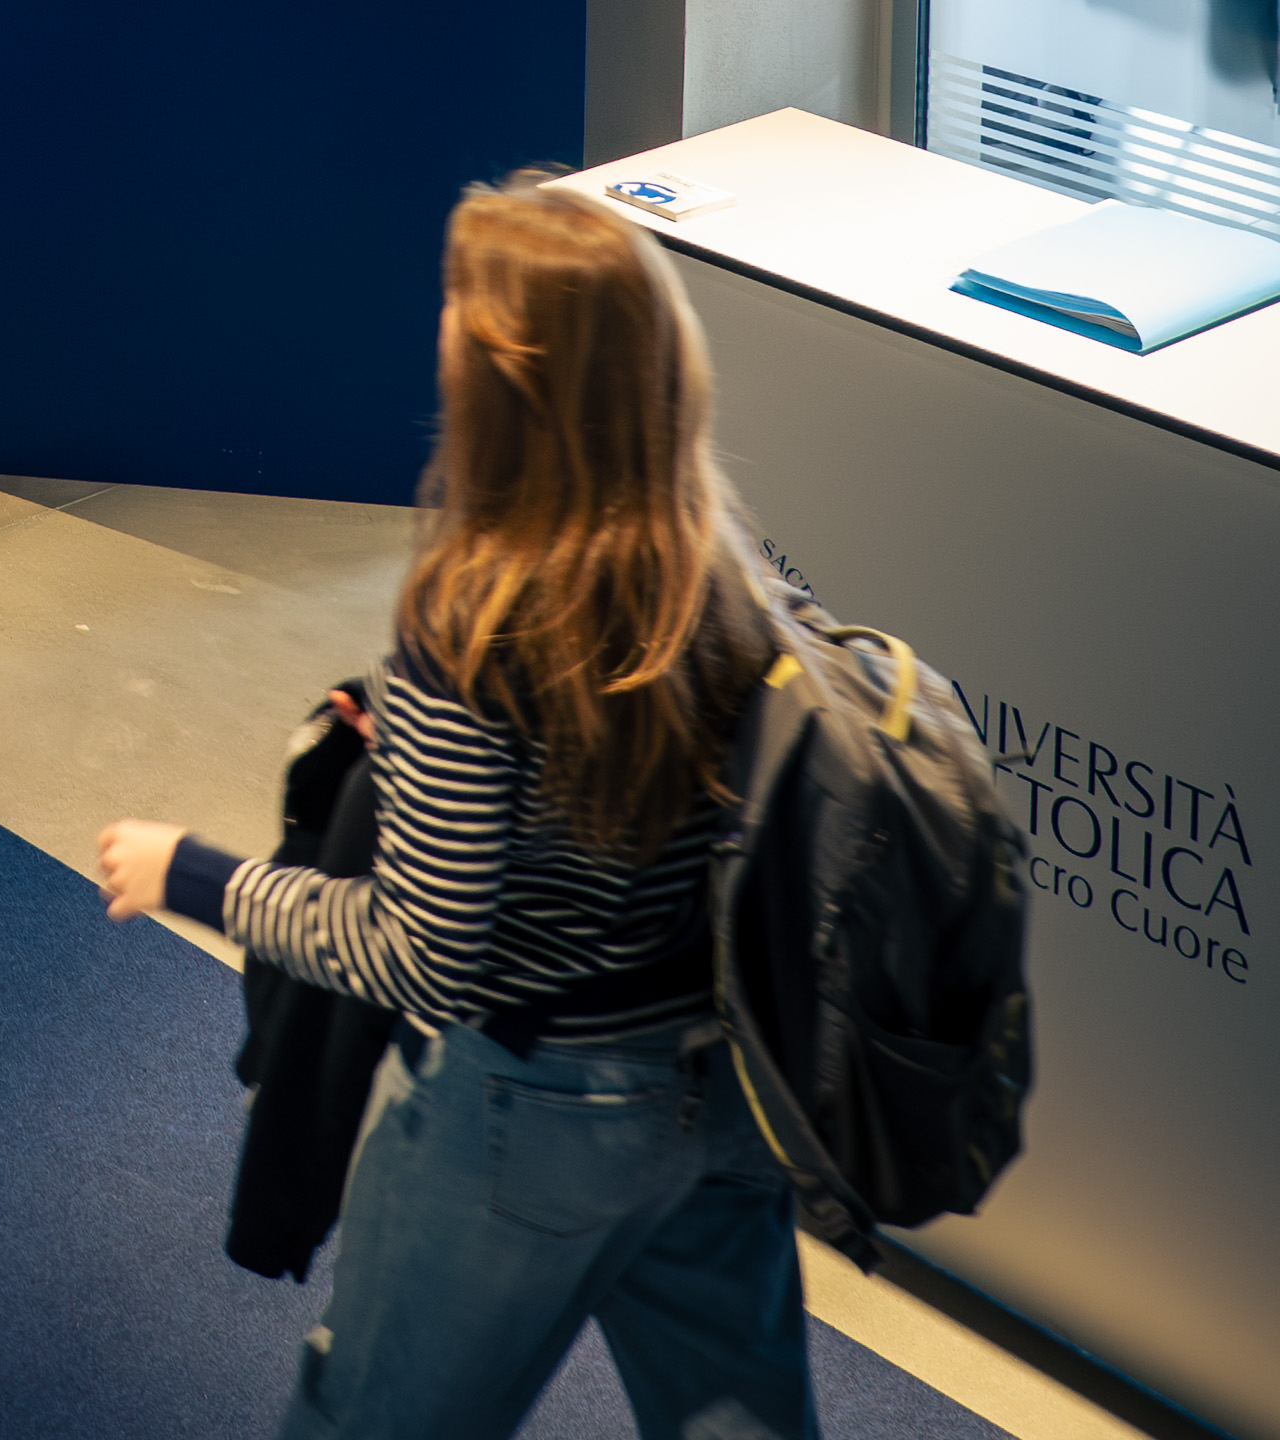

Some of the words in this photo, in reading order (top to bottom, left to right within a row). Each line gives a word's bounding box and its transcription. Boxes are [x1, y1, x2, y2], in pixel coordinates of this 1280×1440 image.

[951, 679, 1252, 867] NIVERSITÀ
[993, 762, 1251, 937] TOLICA
[1030, 856, 1093, 909] cro
[1110, 888, 1249, 985] Cuore
